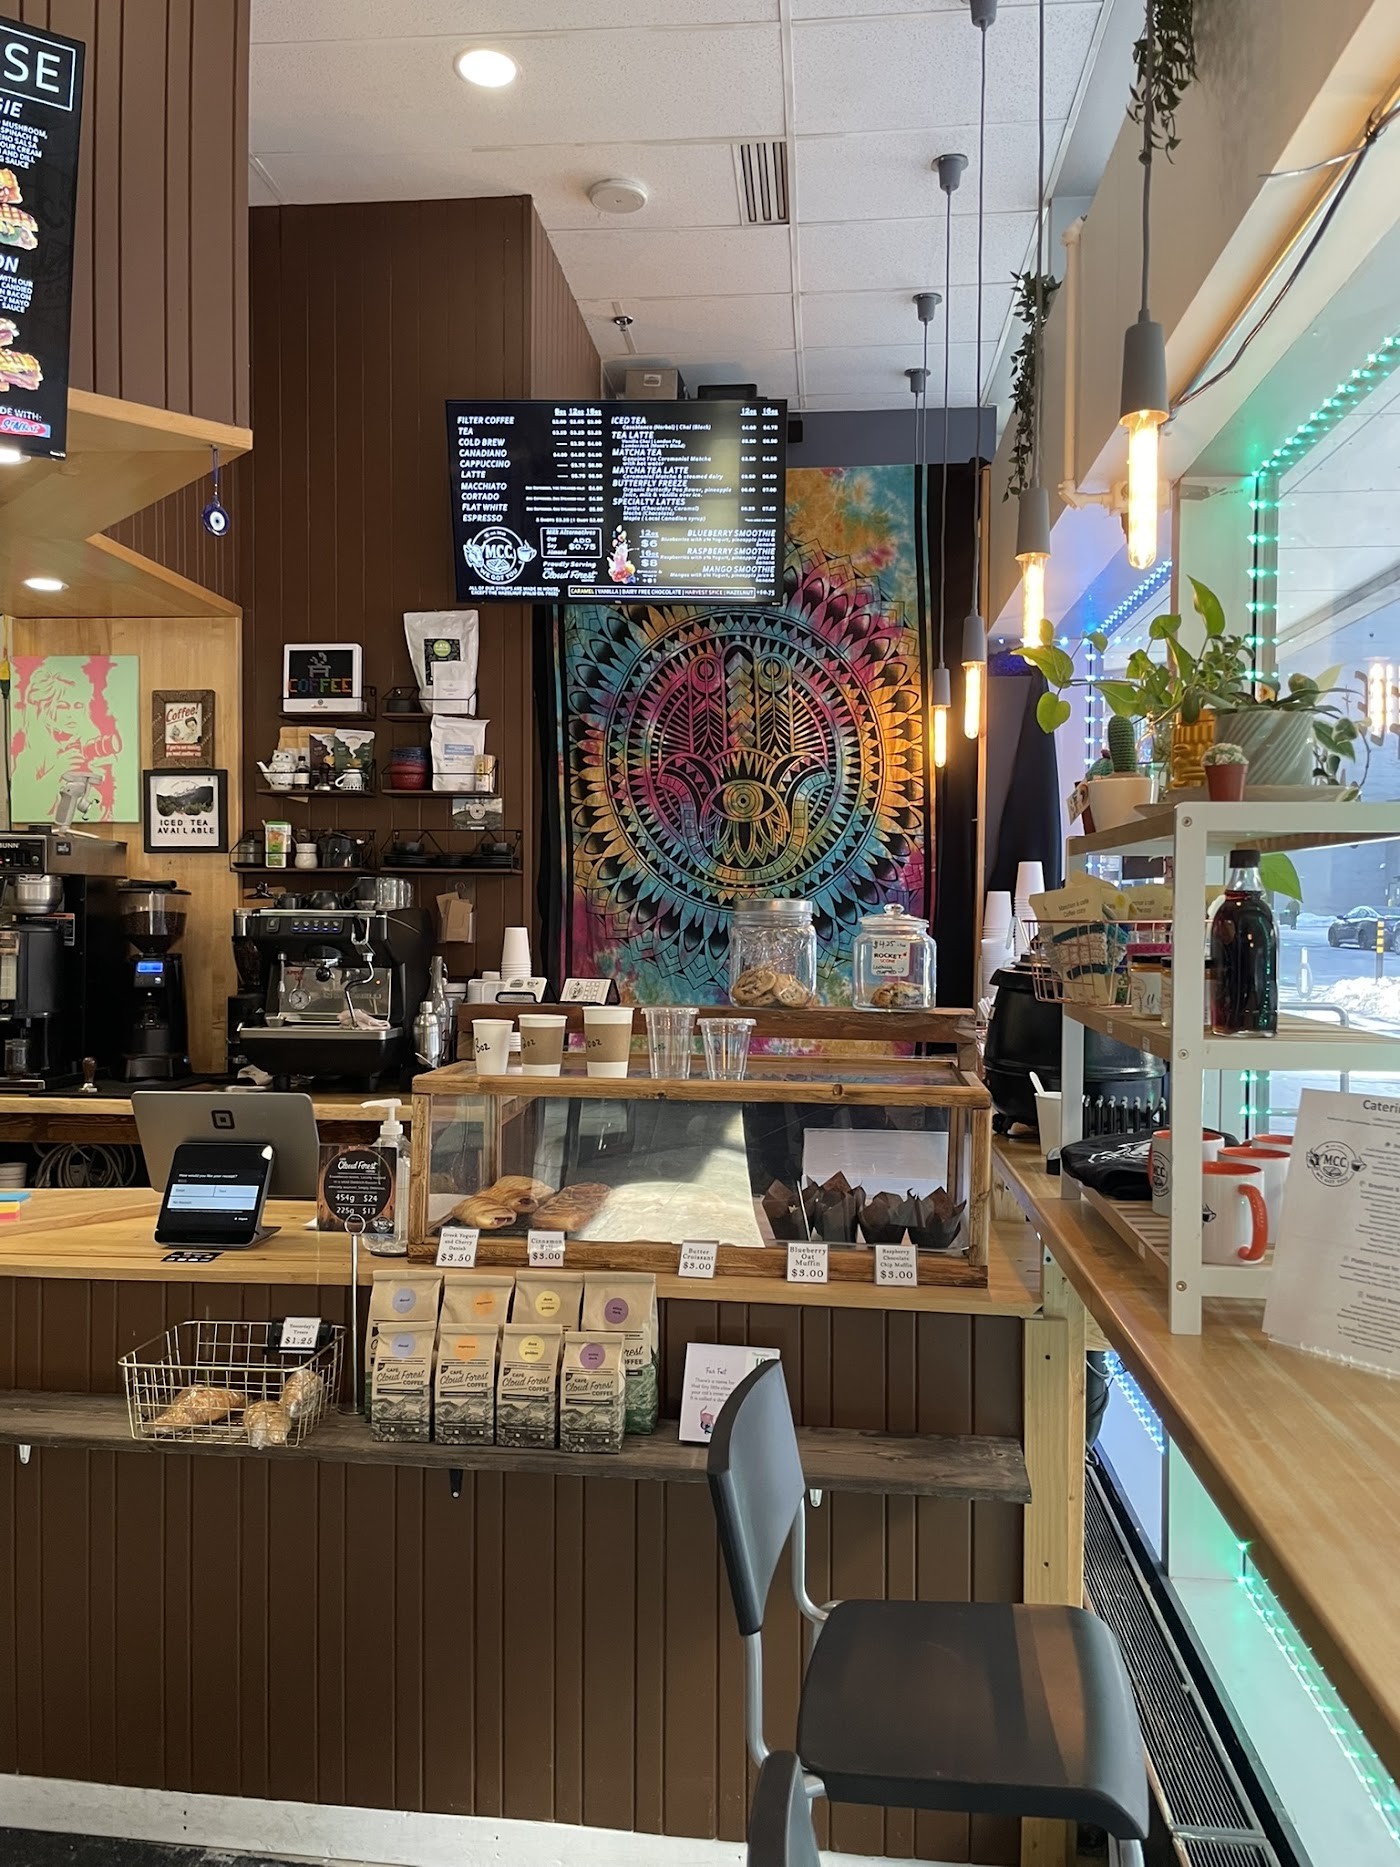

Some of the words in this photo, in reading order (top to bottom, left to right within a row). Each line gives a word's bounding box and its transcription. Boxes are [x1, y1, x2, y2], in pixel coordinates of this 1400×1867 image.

[4, 42, 61, 93] SE
[0, 126, 32, 141] SPINACH
[2, 120, 47, 140] MUSHROOM,
[14, 137, 37, 149] SALSA
[17, 145, 42, 158] CREAM
[2, 149, 19, 158] AND
[19, 153, 36, 164] DILL
[5, 157, 29, 169] SAUCE
[17, 278, 33, 288] OUR
[1, 282, 33, 294] CANDIED
[6, 289, 31, 301] BACON
[9, 297, 30, 308] MAYO
[2, 303, 25, 313] SAUCE
[14, 409, 42, 421] WITH:
[568, 408, 585, 416] 12oz
[740, 408, 757, 416] 12oz
[761, 407, 779, 416] 16oz
[457, 416, 484, 425] FILTER
[484, 416, 515, 425] COFFEE
[611, 416, 631, 425] ICED
[631, 416, 647, 425] TEA
[458, 427, 474, 435] TEA
[611, 431, 628, 440] TEA
[628, 431, 655, 440] LATTE
[458, 438, 481, 446] COLD
[481, 438, 506, 446] BREW
[459, 449, 508, 458] CANADIANO
[612, 449, 646, 457] MATCHA
[647, 449, 662, 457] TEA
[459, 460, 511, 469] CAPPUCCINO
[612, 466, 646, 474] MATCHA
[646, 466, 663, 474] TEA
[663, 466, 689, 474] LATTE
[461, 471, 487, 479] LATTE
[461, 482, 508, 491] MACCHIATO
[612, 479, 658, 488] BUTTERFLY
[658, 479, 688, 488] FREEZE
[461, 493, 500, 501] CORTADO
[612, 498, 656, 506] SPECIALTY
[656, 498, 686, 506] LATTES
[462, 504, 481, 512] FLAT
[482, 504, 508, 512] WHITE
[463, 514, 503, 522] ESPRESSO
[640, 529, 660, 538] 12oz
[687, 529, 733, 537] BLUEBERRY
[734, 529, 776, 537] SMOOTHIE
[568, 543, 597, 551] $0.75
[640, 539, 658, 548] $6
[485, 544, 513, 559] MCC
[640, 550, 660, 558] 16oz
[687, 547, 733, 555] RASPBERRY
[734, 547, 776, 555] SMOOTHIE
[542, 561, 570, 569] Proudly
[570, 561, 597, 569] Serving
[640, 559, 658, 567] $8
[480, 567, 491, 579] WE
[505, 567, 518, 580] YOU
[702, 565, 733, 573] MANGO
[542, 570, 570, 580] Cloud
[570, 569, 598, 579] Forest
[570, 588, 594, 596] CARAMEL
[597, 588, 619, 596] VANILLA
[622, 588, 637, 596] DAIRY
[638, 588, 651, 596] FREE
[651, 588, 682, 596] CHOCOLATE
[684, 588, 708, 596] HARVEST
[708, 588, 723, 596] SPICE
[288, 678, 352, 693] COFFEE
[166, 703, 199, 723] Coffee!
[157, 827, 215, 835] AVAILABLE
[1063, 910, 1076, 918] Coffee
[337, 1160, 359, 1170] Cloud
[358, 1160, 378, 1170] Forest
[1324, 1154, 1348, 1168] MCC
[335, 1193, 355, 1204] 454g
[363, 1194, 378, 1203] $24
[362, 1207, 376, 1215] $13
[789, 1246, 826, 1256] Blueberry
[440, 1253, 472, 1263] $3.50
[532, 1252, 561, 1261] $3.00
[683, 1261, 712, 1271] $3.00
[795, 1259, 821, 1267] Muffin
[791, 1268, 824, 1278] $3.00
[880, 1270, 913, 1279] $3.00
[285, 1336, 313, 1345] $1.25
[624, 1346, 644, 1357] rest
[377, 1372, 400, 1382] Cloud
[401, 1369, 425, 1380] Forest
[706, 1367, 716, 1375] Fun
[717, 1367, 728, 1375] Fact
[440, 1375, 464, 1386] Cloud
[465, 1372, 489, 1382] Forest
[502, 1376, 525, 1387] Cloud
[527, 1376, 550, 1386] Forest
[565, 1382, 589, 1392] Cloud
[590, 1380, 614, 1391] Forest
